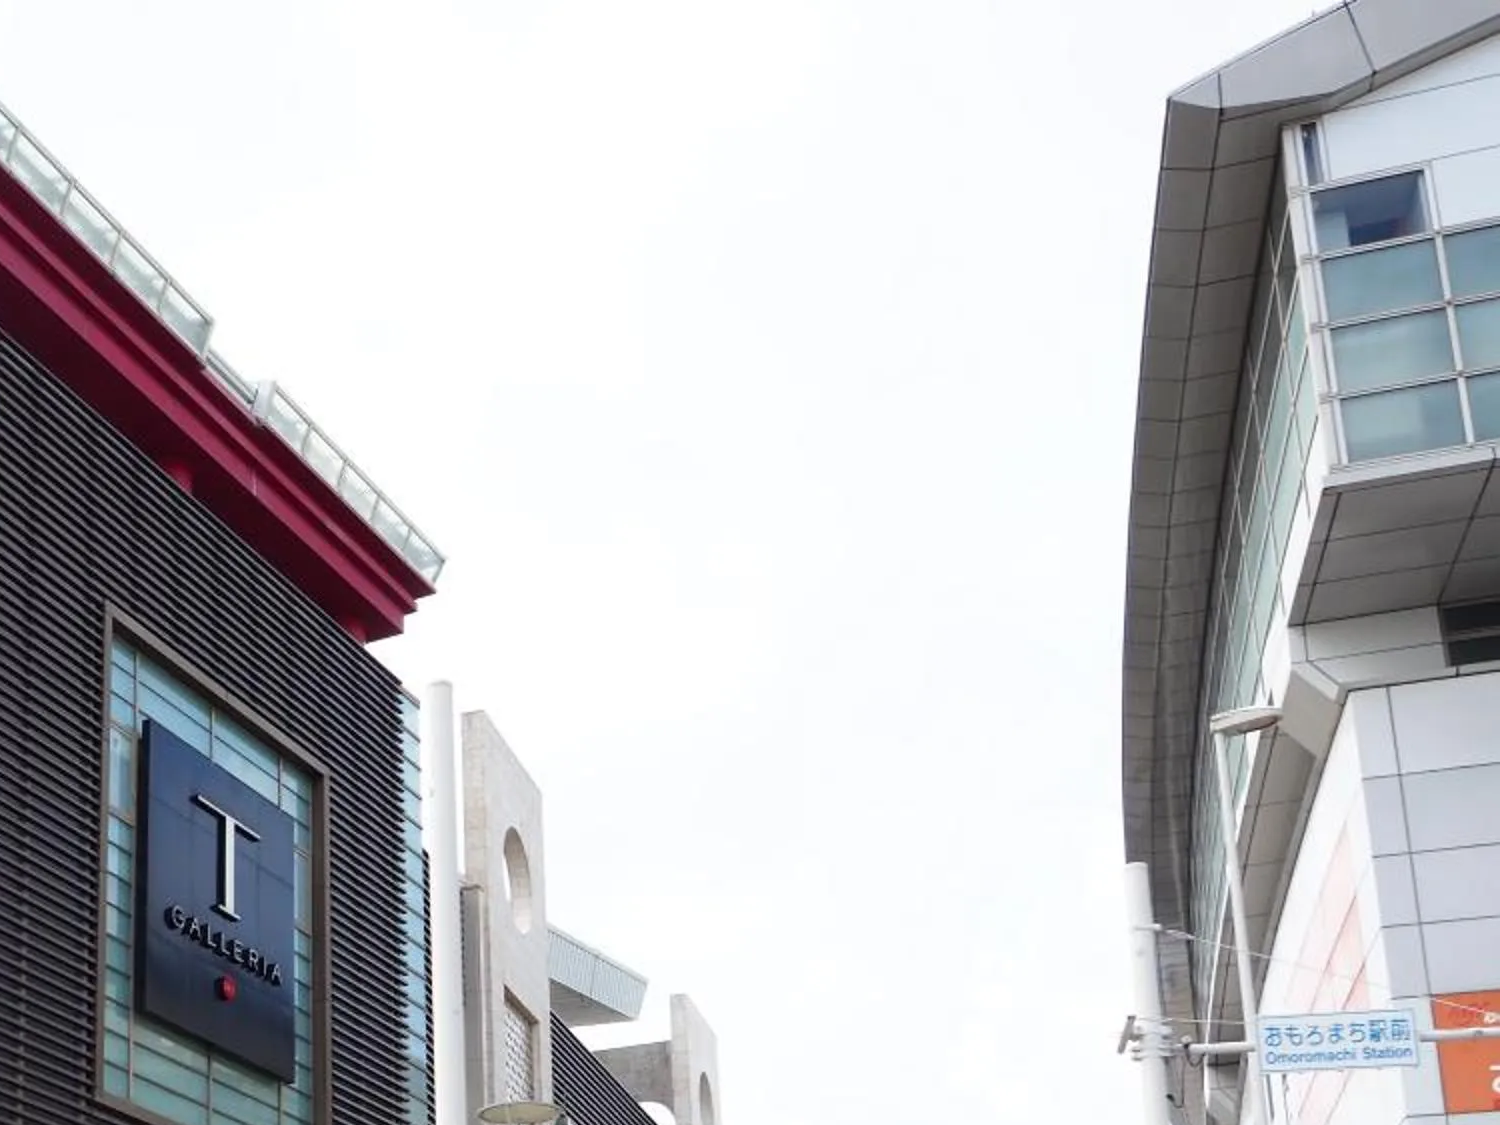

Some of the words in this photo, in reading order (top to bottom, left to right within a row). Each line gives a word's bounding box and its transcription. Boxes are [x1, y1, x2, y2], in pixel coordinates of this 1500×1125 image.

[197, 794, 261, 922] T
[167, 904, 283, 986] GALLERIA
[1264, 1018, 1411, 1047] おもろまち駅前
[1265, 1047, 1356, 1065] Omoromachi
[1363, 1045, 1414, 1060] Station
